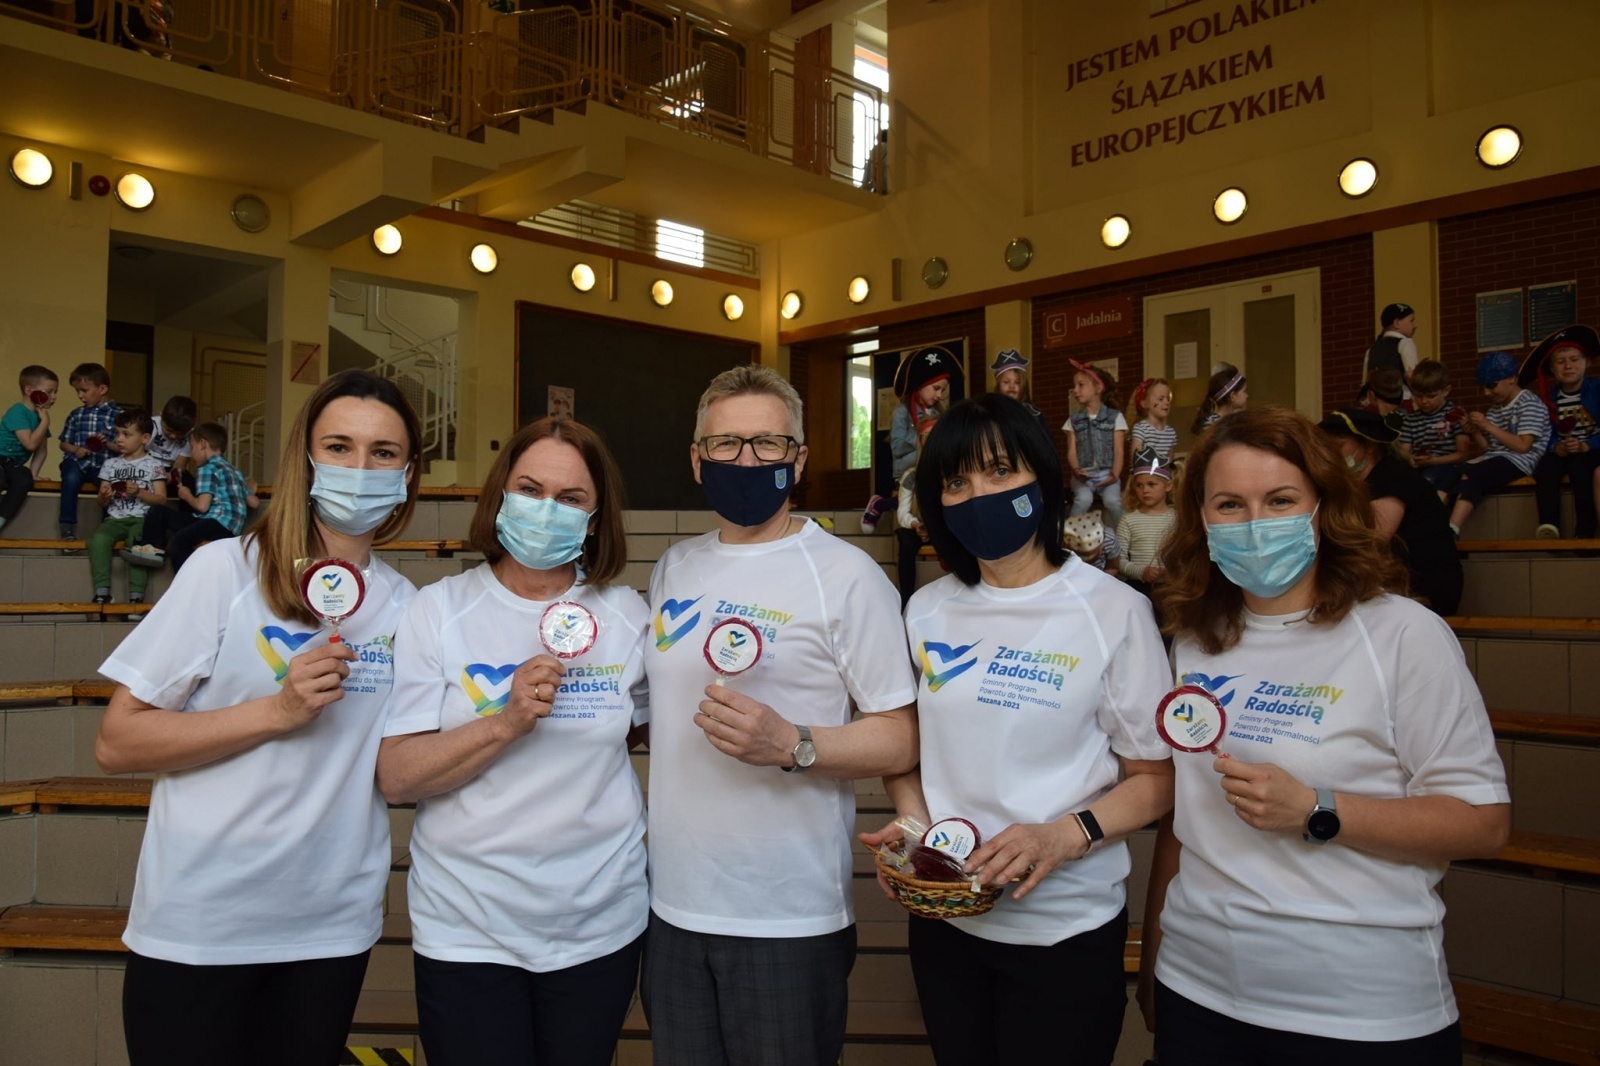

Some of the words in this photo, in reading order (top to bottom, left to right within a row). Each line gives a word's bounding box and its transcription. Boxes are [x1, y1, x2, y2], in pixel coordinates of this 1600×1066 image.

[1065, 34, 1160, 92] JESTEM
[1111, 44, 1273, 114] ŚLĄZAKIEM
[1071, 75, 1326, 167] EUROPEJCZYKIEM
[1051, 317, 1062, 333] C
[1076, 309, 1122, 330] Jadalnia
[114, 467, 145, 479] WOULD
[715, 600, 794, 625] Zarażamy
[994, 646, 1080, 672] Zarażamy
[555, 678, 620, 695] adością
[982, 678, 1006, 688] Gminny
[1007, 682, 1037, 694] Program
[987, 661, 1065, 691] Radością
[977, 695, 1001, 706] Mszana
[1002, 700, 1020, 710] 2021
[979, 686, 1006, 697] Powrotu
[1007, 691, 1016, 699] do
[1018, 693, 1062, 709] Normalności
[1254, 681, 1344, 705] Zarażamy
[1239, 714, 1263, 723] Gminny
[1263, 717, 1293, 727] Program
[1244, 696, 1325, 725] Radością
[1229, 730, 1254, 741] Mszana
[1255, 735, 1273, 744] 2021
[1234, 721, 1261, 732] Powrotu
[1262, 725, 1270, 733] do
[1271, 728, 1320, 745] Normalności
